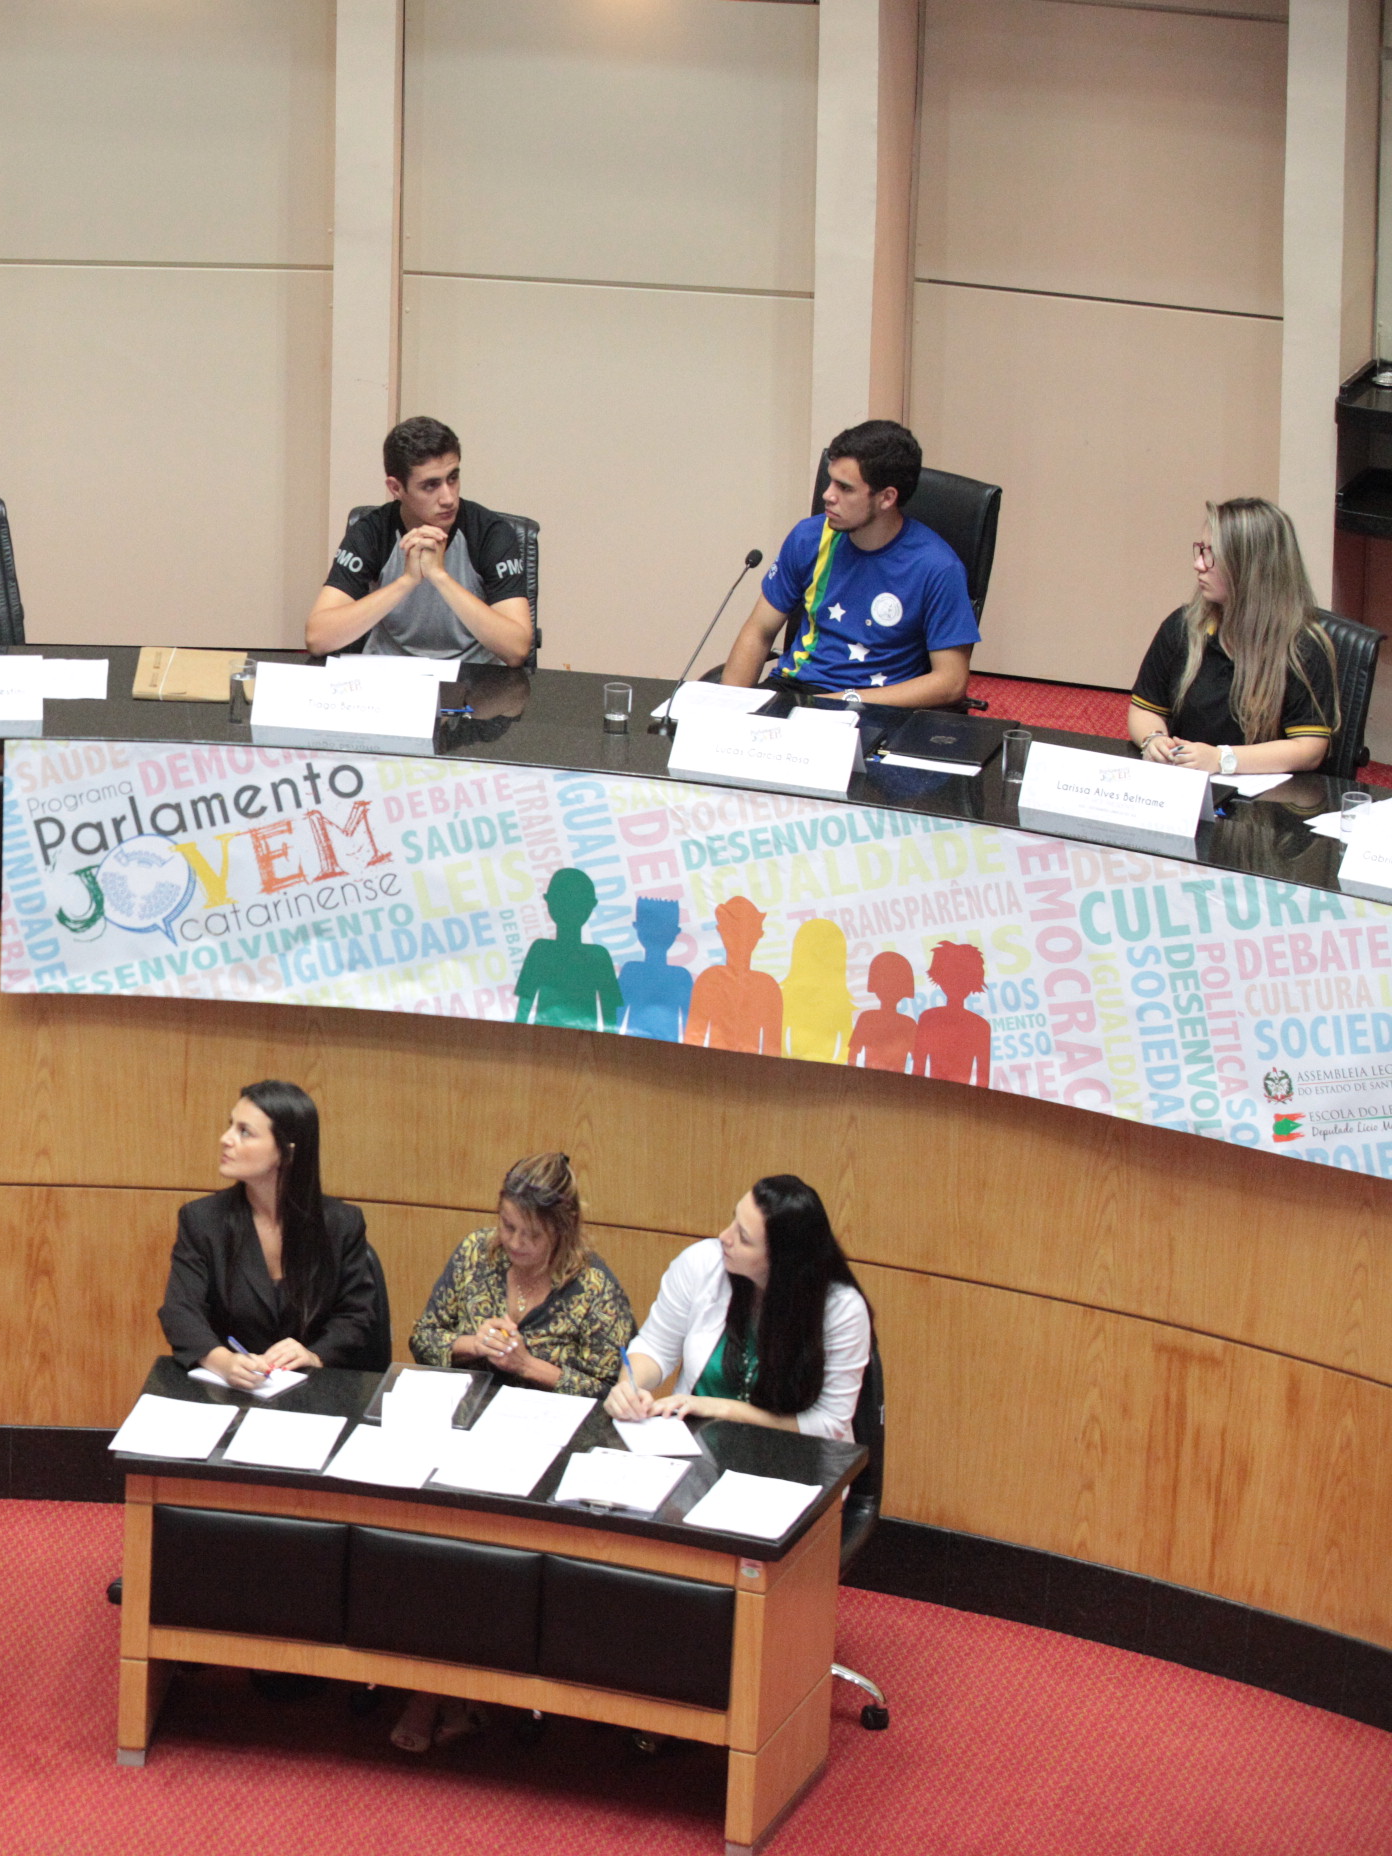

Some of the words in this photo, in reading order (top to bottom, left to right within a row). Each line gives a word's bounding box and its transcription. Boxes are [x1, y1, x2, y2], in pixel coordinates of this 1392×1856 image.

[786, 753, 811, 766] Rosa
[26, 780, 133, 818] Programa
[33, 763, 364, 866] Parlamento
[383, 772, 514, 824] DEBATE
[1056, 780, 1091, 795] Larissa
[1093, 786, 1121, 801] Alves
[1123, 791, 1166, 808] Beltrame
[401, 809, 522, 864] SAÚDE
[412, 851, 536, 920] LEIS
[179, 872, 402, 942] catarinense
[277, 911, 497, 988] IGUALDADE
[1243, 974, 1375, 1018] CULTURA
[1297, 1065, 1368, 1083] ASSEMBLEIA
[1298, 1086, 1313, 1097] DO
[1315, 1083, 1352, 1096] ESTADO
[1354, 1082, 1368, 1092] DE
[1309, 1109, 1356, 1123] ESCOLA
[1358, 1105, 1379, 1118] DO
[1312, 1122, 1354, 1141] Deputado
